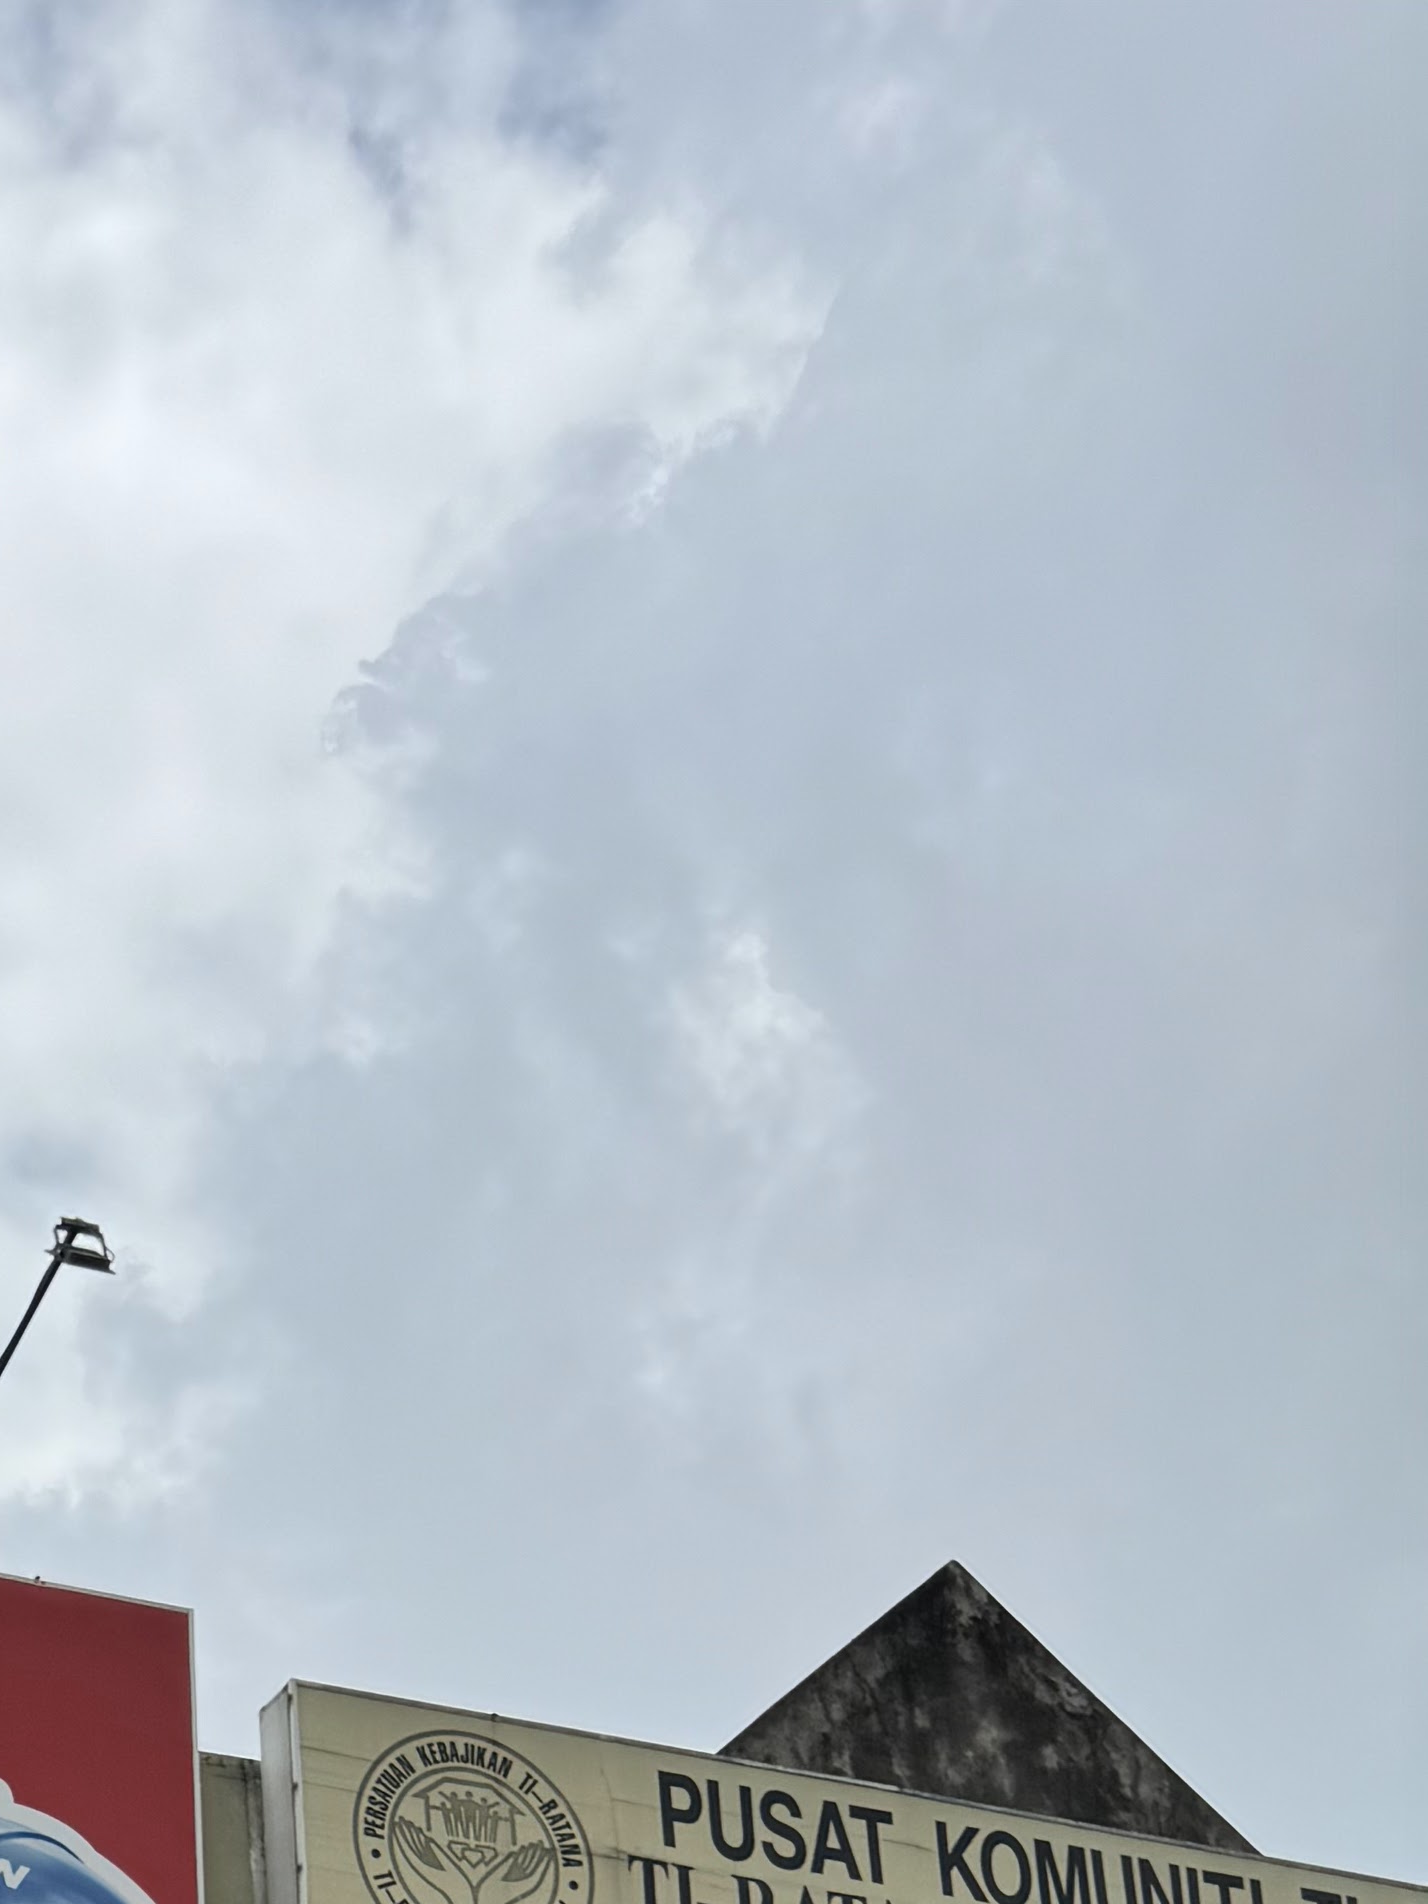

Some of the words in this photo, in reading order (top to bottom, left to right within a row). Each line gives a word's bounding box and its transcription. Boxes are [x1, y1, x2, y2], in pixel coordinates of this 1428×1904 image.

[363, 1754, 416, 1840] PERSATUAN
[416, 1741, 514, 1778] KEBAJIKAN
[658, 1770, 893, 1885] PUSAT
